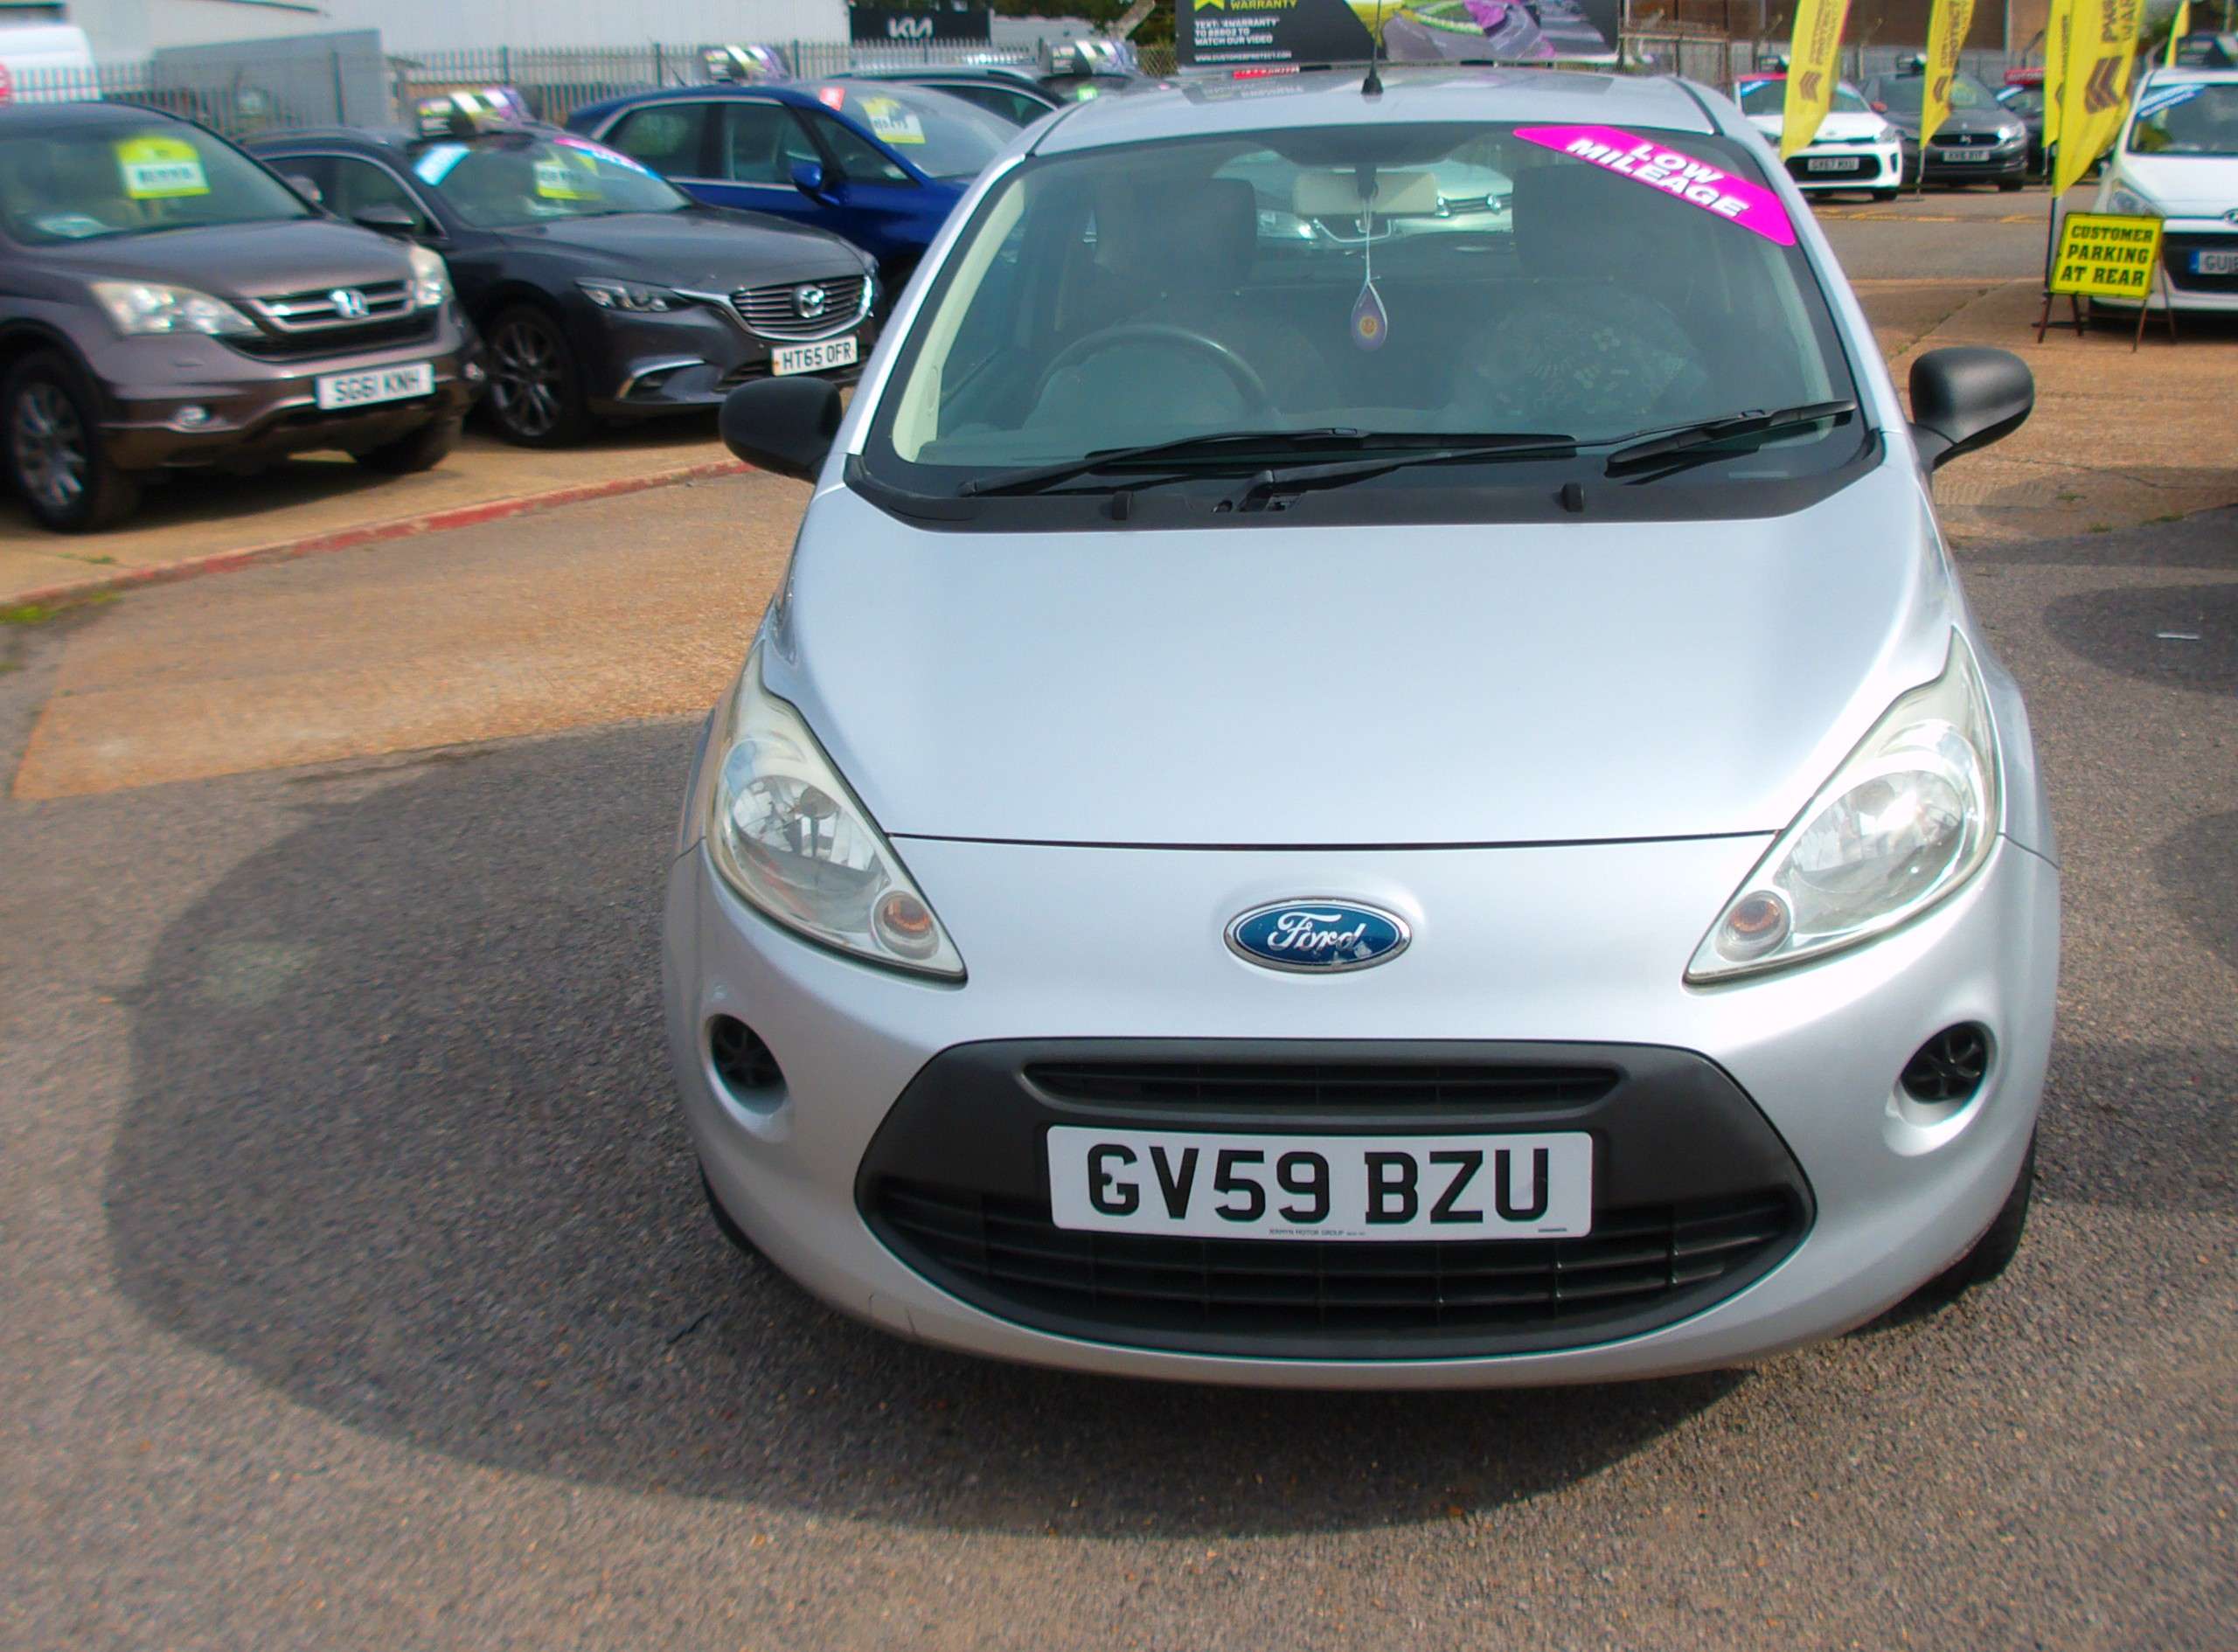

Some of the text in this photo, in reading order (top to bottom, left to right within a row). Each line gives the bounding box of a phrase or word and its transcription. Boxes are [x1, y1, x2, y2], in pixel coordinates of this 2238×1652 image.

[1231, 0, 1297, 10] WARRANTY
[1195, 37, 1226, 45] WATCH
[1247, 34, 1274, 44] VIDEO
[1630, 143, 1725, 184] LOW
[1565, 137, 1751, 218] MILEAGE
[2071, 225, 2154, 243] CUSTOMER
[2067, 244, 2150, 264] PARKING
[2060, 265, 2146, 287] AT REAR
[782, 346, 823, 370] HT65
[1267, 911, 1367, 951] Ford
[1087, 1143, 1549, 1225] GV59 BZU
